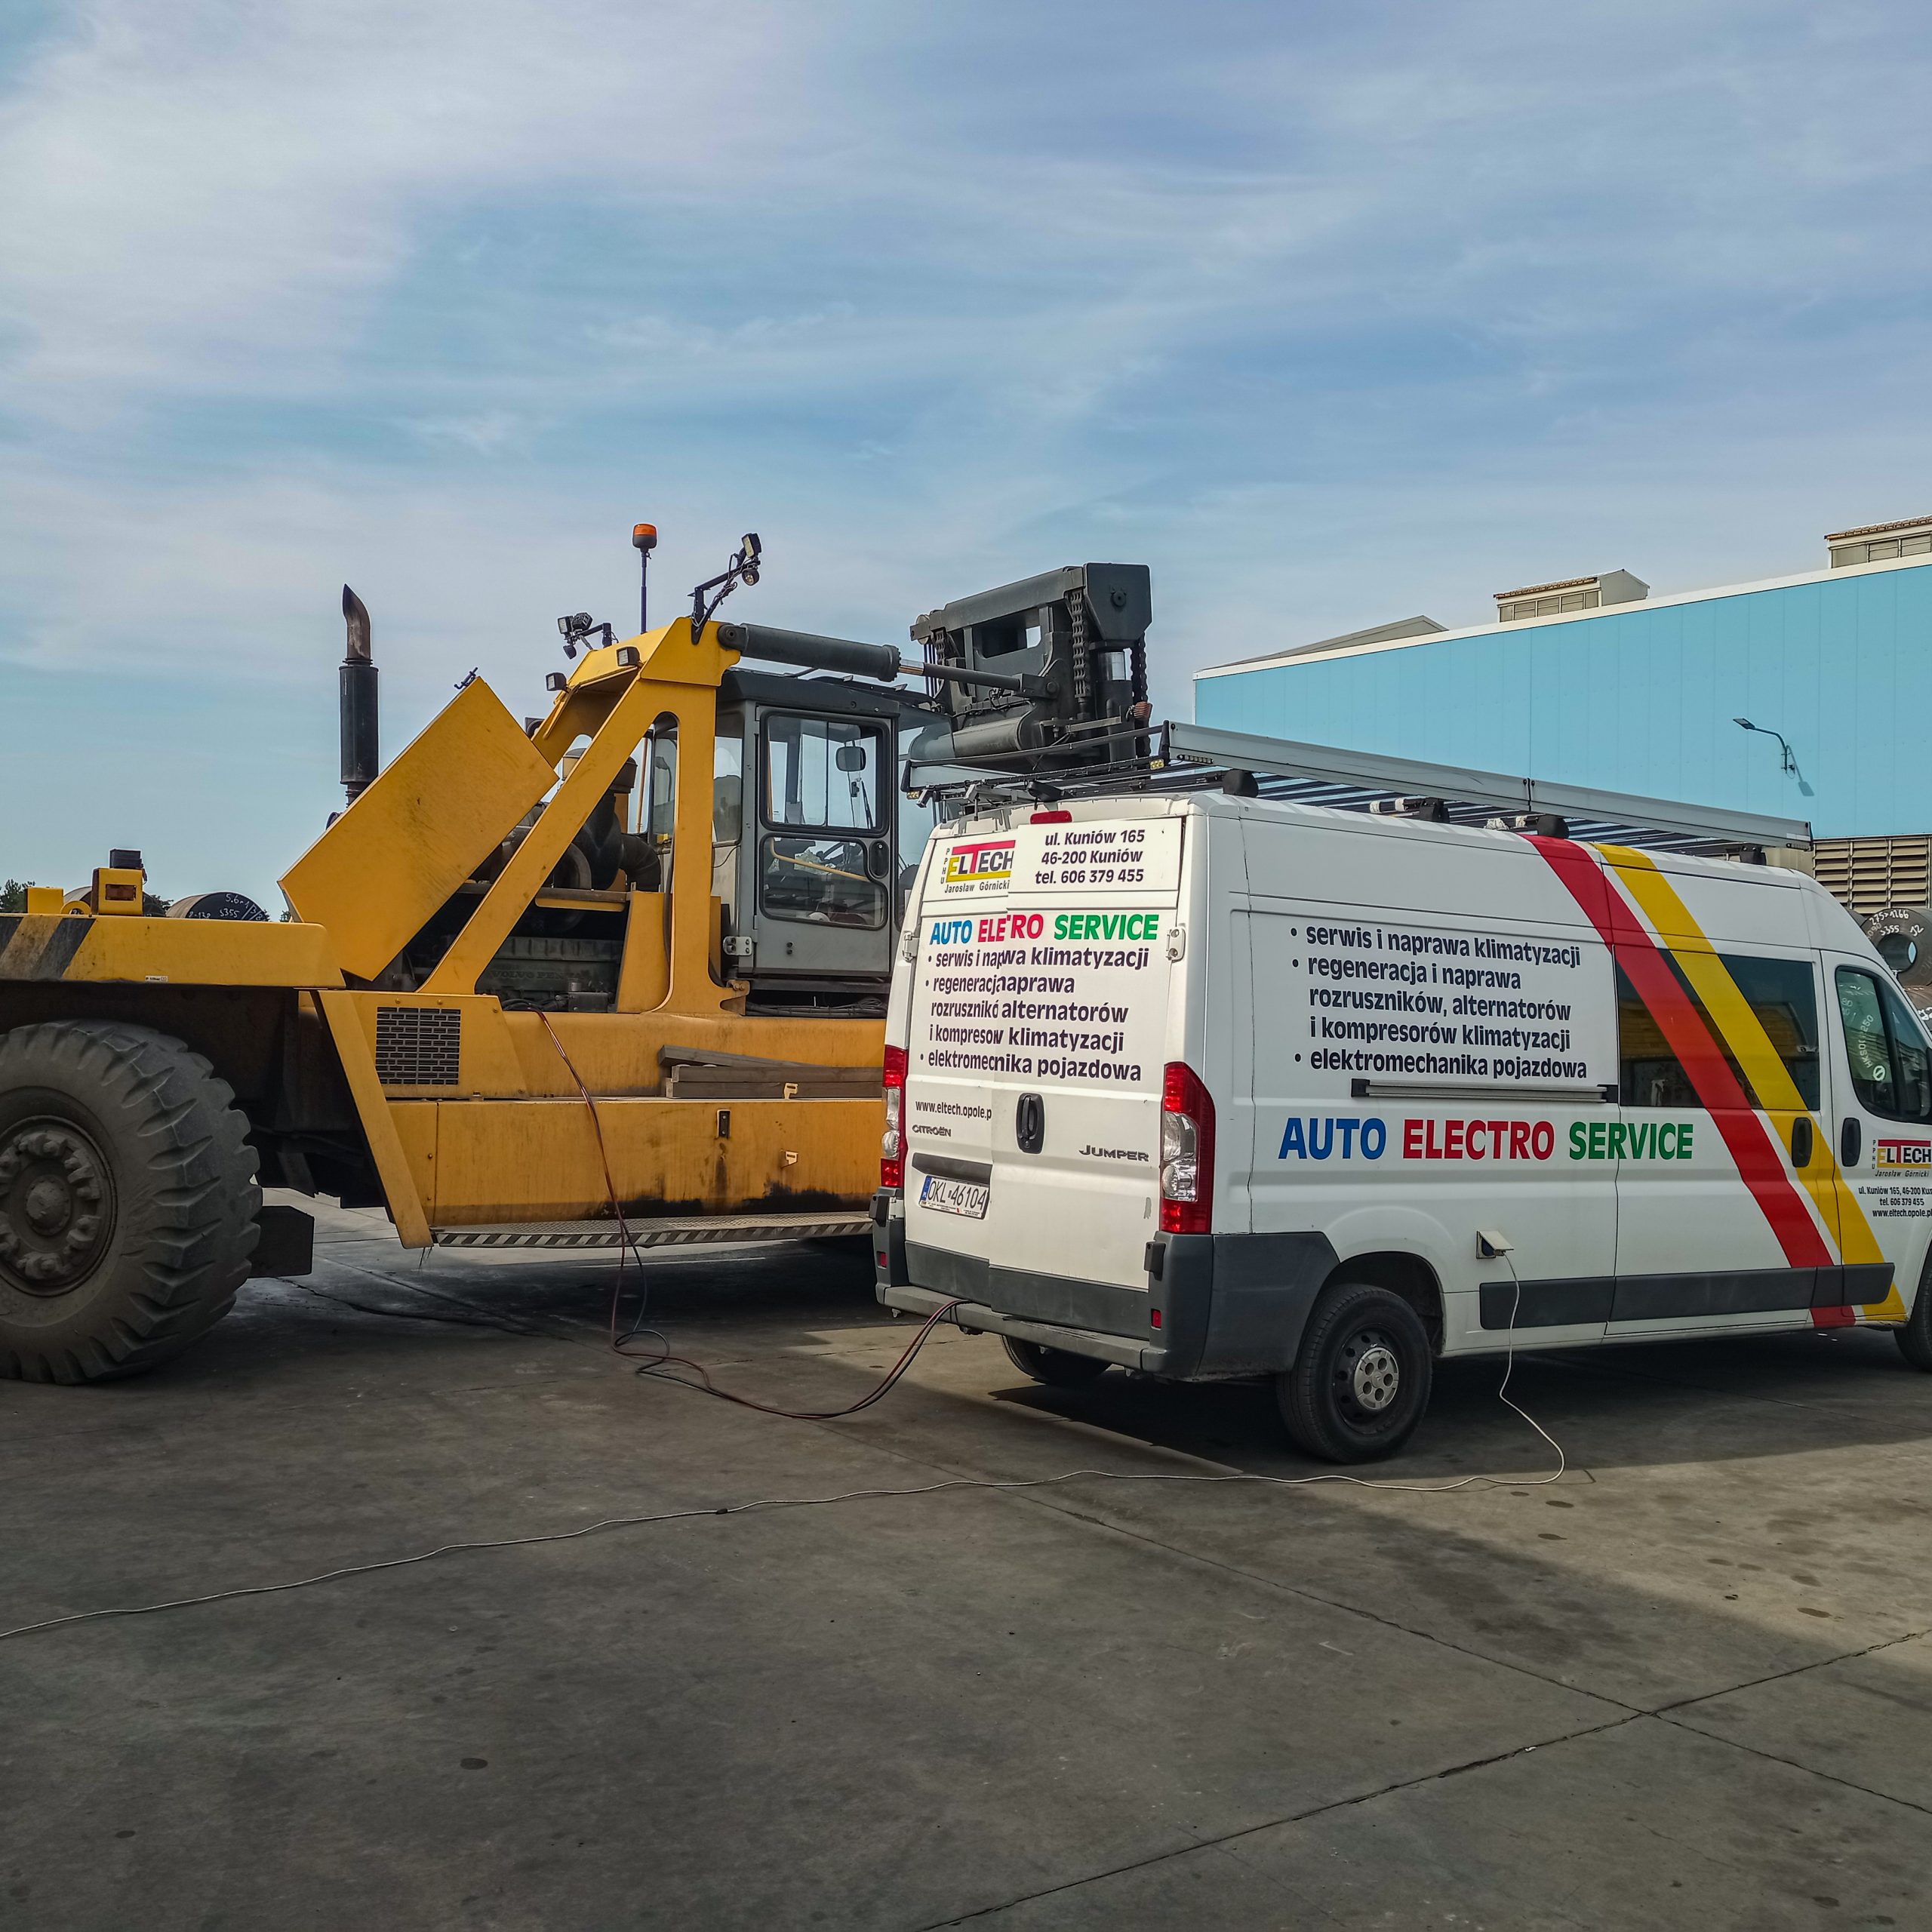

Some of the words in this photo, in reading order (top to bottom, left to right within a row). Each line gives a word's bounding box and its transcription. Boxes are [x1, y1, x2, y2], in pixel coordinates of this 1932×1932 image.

[1045, 832, 1060, 845] ul.
[1064, 830, 1116, 845] Kuniów
[1120, 829, 1145, 843] 165
[946, 840, 1016, 882] ELTECH
[1041, 851, 1087, 865] 46-200
[1090, 848, 1143, 863] Kuniów
[979, 880, 1010, 891] Górnicki
[1035, 871, 1057, 884] tel.
[1061, 870, 1085, 884] 606
[1089, 869, 1114, 883] 379
[1118, 869, 1144, 882] 455
[929, 919, 973, 945] AUTO
[1054, 914, 1159, 940] SERVICE
[936, 949, 974, 967] serwis
[976, 949, 980, 966] i
[1030, 947, 1149, 971] klimatyzacji
[1306, 926, 1372, 949] serwis
[1377, 928, 1383, 949] i
[1388, 933, 1470, 957] naprawa
[1475, 937, 1580, 968] klimatyzacji
[1308, 956, 1427, 985] regeneracja
[1432, 963, 1437, 983] i
[1442, 967, 1521, 989] naprawa
[1001, 1000, 1129, 1023] alternatorów
[1309, 988, 1447, 1017] rozruszników,
[1453, 995, 1571, 1020] alternatorów
[929, 1024, 934, 1041] i
[1008, 1027, 1124, 1054] klimatyzacji
[1310, 1016, 1316, 1038] i
[1321, 1017, 1457, 1044] kompresorów
[1462, 1024, 1571, 1052] klimatyzacji
[1037, 1057, 1141, 1081] pojazdowa
[1310, 1048, 1487, 1075] elektromechanika
[1493, 1057, 1587, 1079] pojazdowa
[915, 1101, 992, 1121] www.eltech.opole.p
[1278, 1117, 1386, 1160] AUTO
[1402, 1118, 1555, 1160] ELECTRO
[1568, 1121, 1694, 1161] SERVICE
[1078, 1144, 1149, 1162] JUMPER
[1877, 1139, 1931, 1168] ELTECH
[928, 1180, 946, 1204] OKL
[950, 1185, 987, 1211] 46104
[1858, 1186, 1866, 1195] ul.
[1866, 1186, 1888, 1195] Kuniów
[1879, 1198, 1889, 1206] tel.
[1890, 1198, 1900, 1206] 606
[1901, 1198, 1912, 1206] 379
[1912, 1198, 1924, 1206] 455
